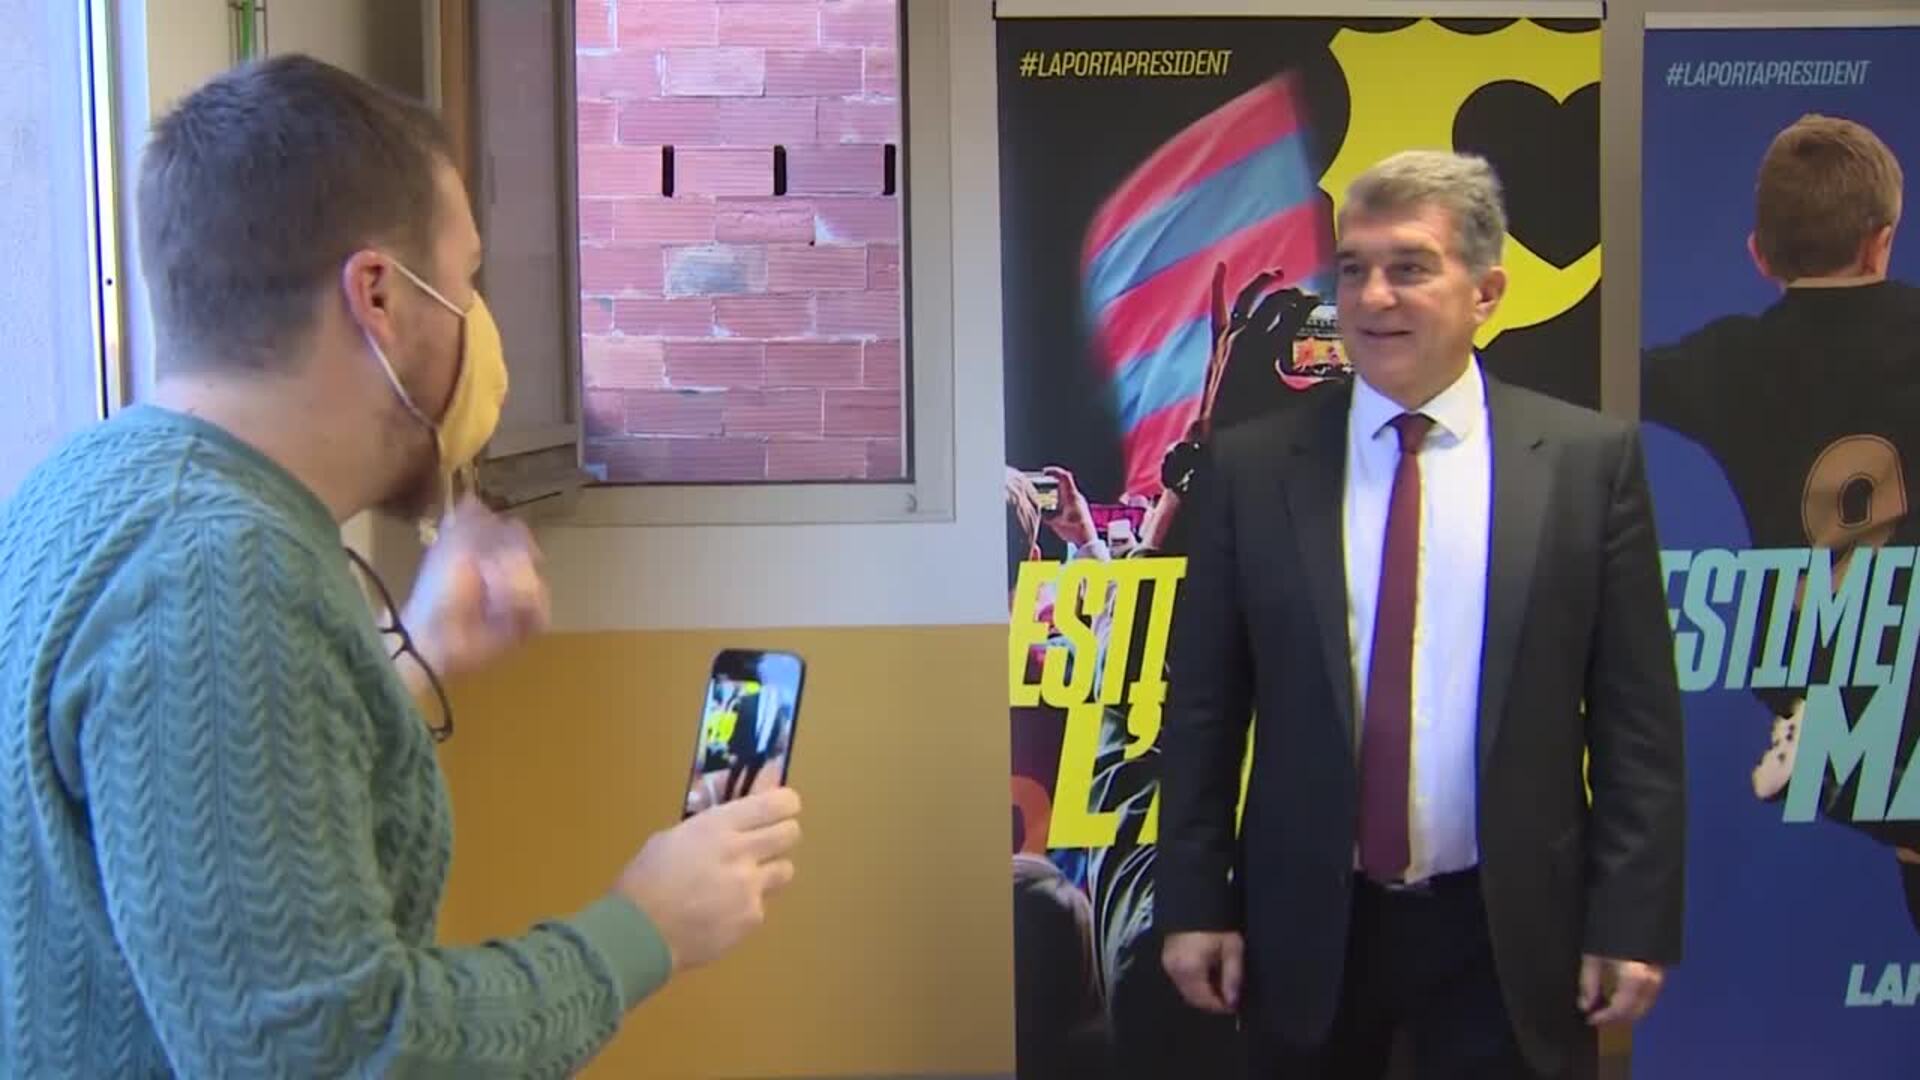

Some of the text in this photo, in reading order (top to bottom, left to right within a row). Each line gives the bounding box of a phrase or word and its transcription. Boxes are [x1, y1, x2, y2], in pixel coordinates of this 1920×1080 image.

[1019, 50, 1232, 77] #LAPORTAPRESIDENT
[1666, 60, 1872, 86] #LAPORTAPRESIDENT
[1047, 700, 1161, 848] L'
